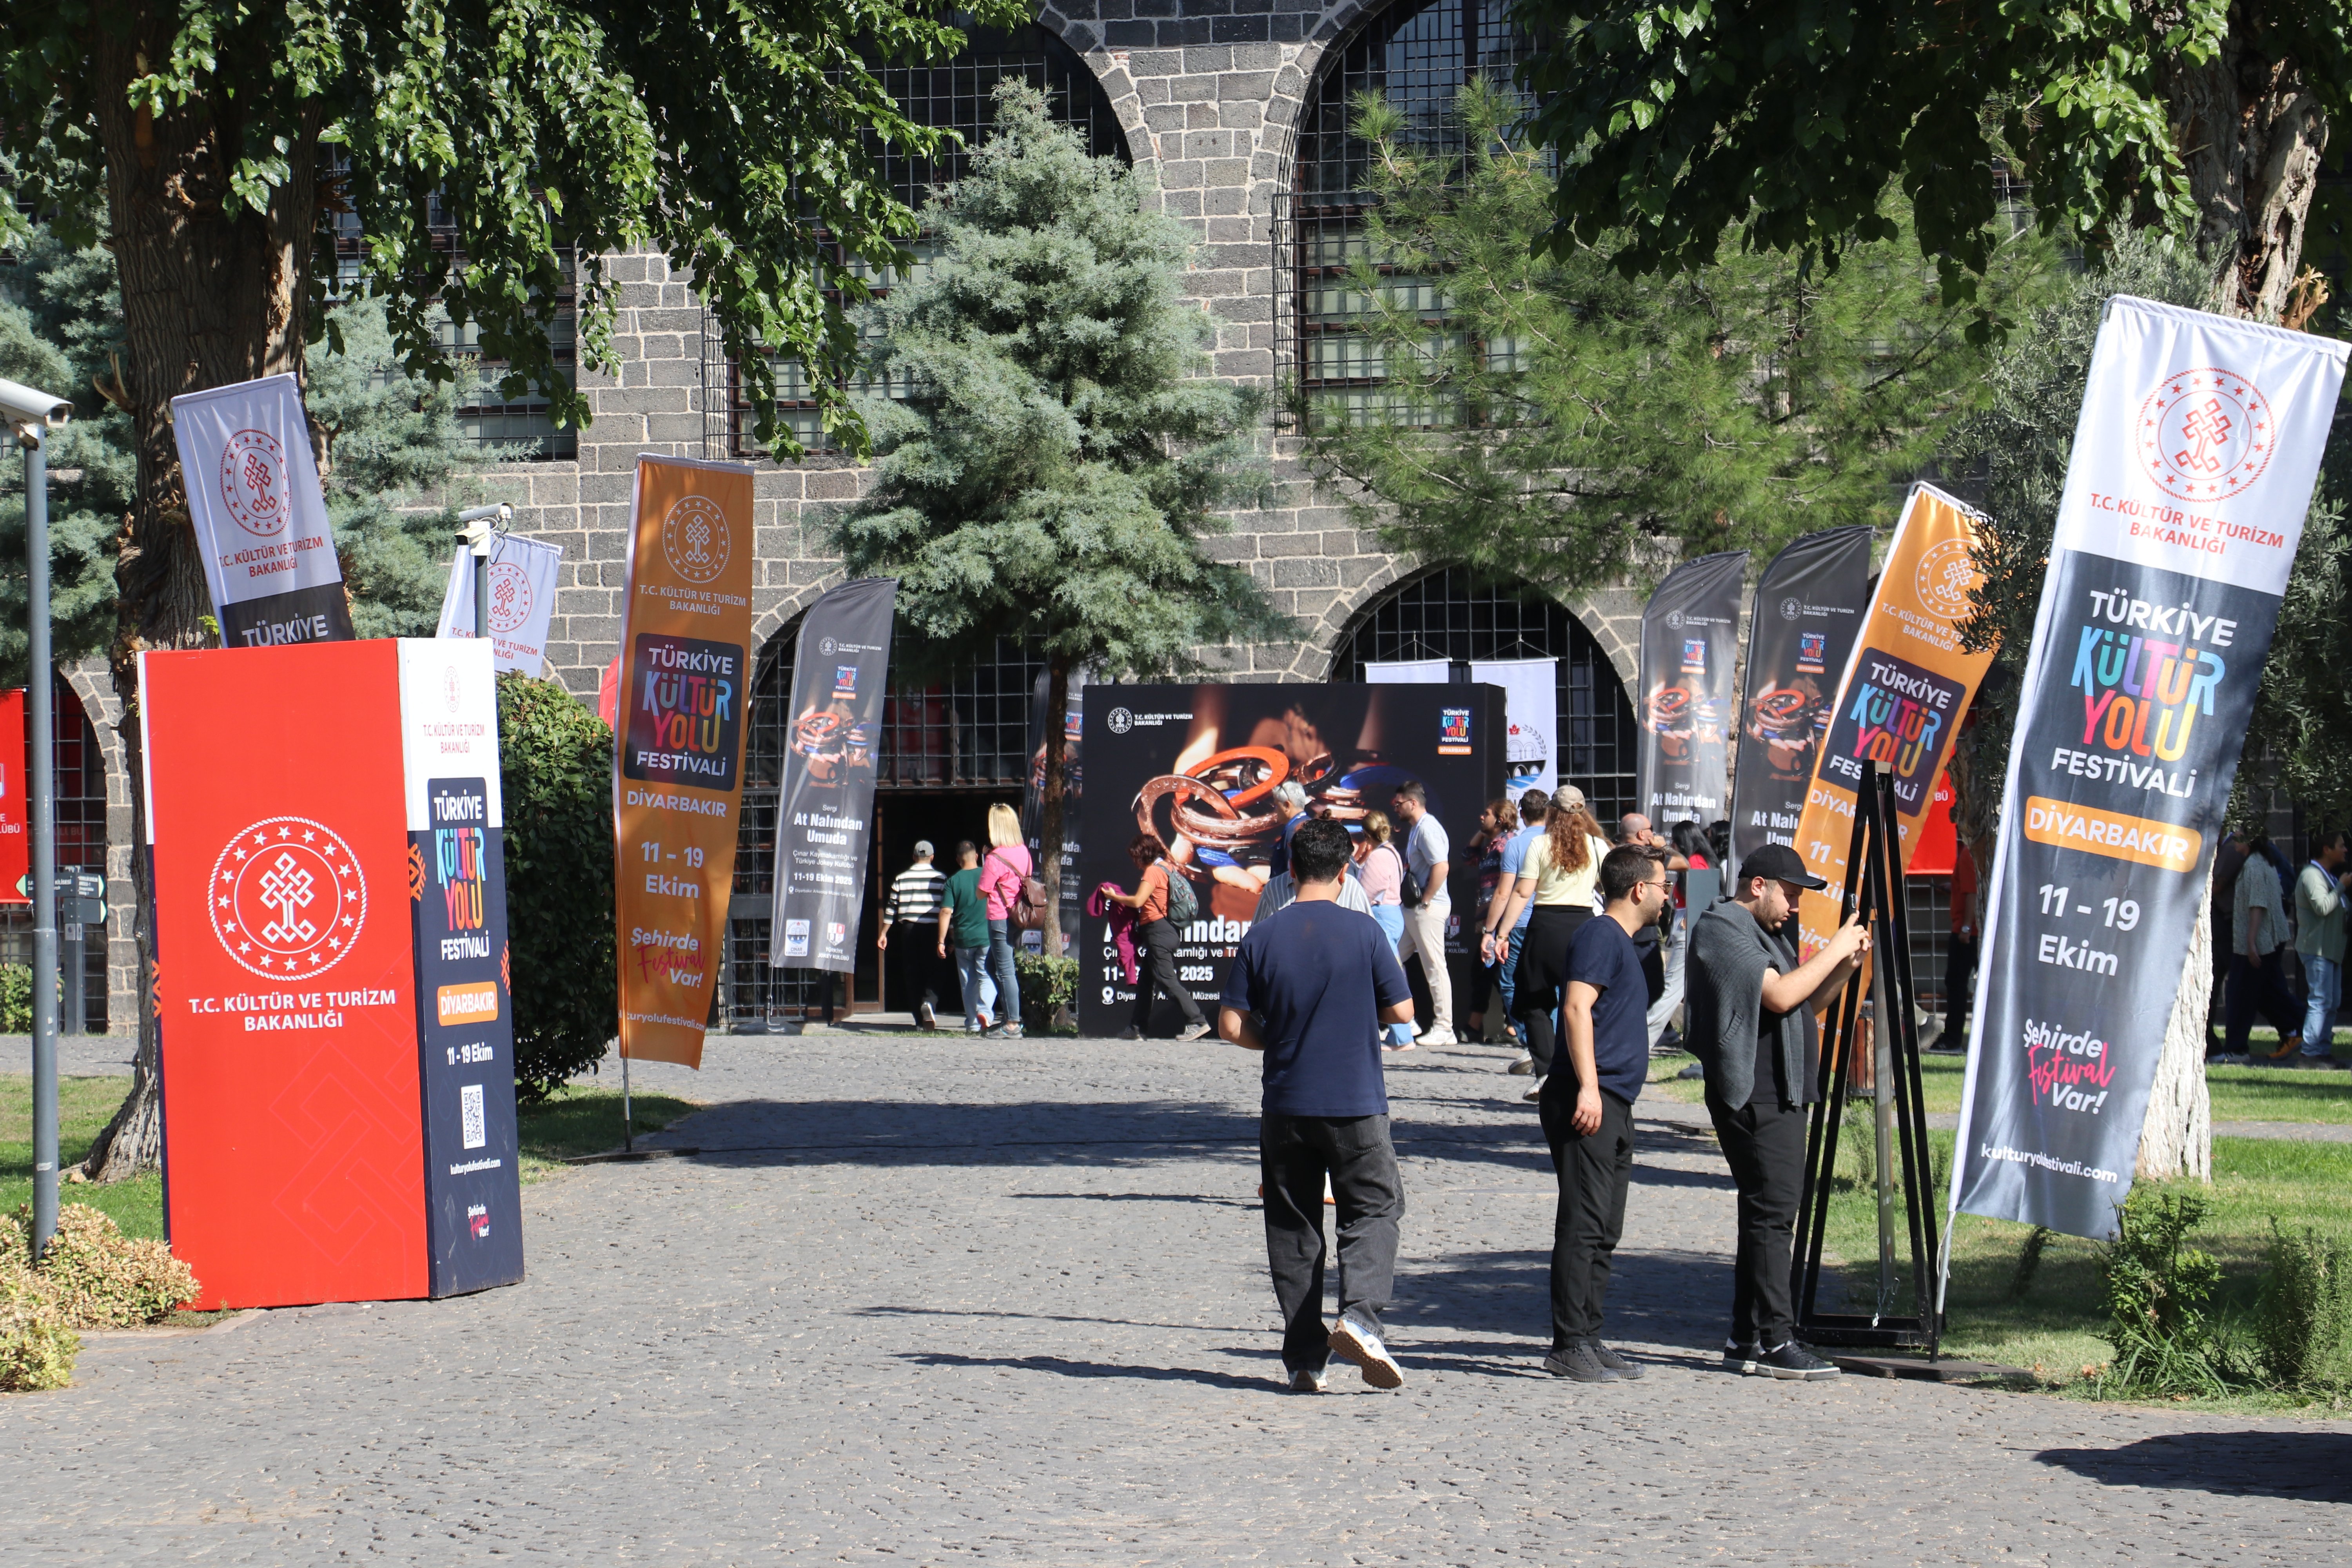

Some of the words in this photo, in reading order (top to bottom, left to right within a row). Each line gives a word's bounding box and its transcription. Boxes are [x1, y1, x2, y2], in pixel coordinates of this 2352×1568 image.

[2091, 493, 2114, 511] T.C.
[2117, 499, 2184, 526] KÜLTÜR
[2190, 515, 2210, 532] VE
[2216, 521, 2284, 549] TURİZM
[234, 545, 275, 564] KÜLTÜR
[277, 544, 287, 555] VE
[288, 536, 323, 553] TURİZM
[2130, 522, 2226, 555] BAKANLIĞI
[249, 557, 297, 577] BAKANLIĞI
[640, 585, 657, 596] T.C.
[661, 586, 697, 600] KÜLTÜR
[700, 592, 711, 602] VE
[713, 593, 746, 606] TURİZM
[670, 601, 720, 615] BAKANLIĞI
[242, 613, 328, 647] TÜRKİYE
[1882, 603, 1896, 616] T.C.
[1898, 610, 1934, 633] KÜLTÜR
[1936, 624, 1949, 637] VE
[2090, 588, 2237, 647] TÜRKİYE
[452, 627, 463, 637] T.C.
[508, 642, 538, 656] TURİZM
[1802, 639, 1824, 650] KÜLTÜR
[1903, 624, 1955, 652] BAKANLIĞI
[648, 644, 733, 675] TÜRKİYE
[1687, 653, 1702, 661] YOLU
[1804, 648, 1821, 657] YOLU
[837, 671, 856, 680] KÜLTÜR
[2071, 626, 2226, 716] KÜLTÜR
[642, 671, 731, 721] KÜLTÜR
[1871, 662, 1952, 710] TÜRKİYE
[423, 725, 433, 737] T.C.
[434, 722, 455, 736] KÜLTÜR
[456, 724, 463, 736] VE
[464, 722, 485, 736] TURİZM
[1443, 716, 1469, 728] KÜLTÜR
[1850, 683, 1942, 752] KÜLTÜR
[2083, 689, 2198, 762] YOLU
[653, 711, 721, 753] YOLU
[1446, 726, 1466, 737] YOLU
[441, 739, 470, 753] BAKANLIĞI
[1853, 726, 1924, 778] YOLU
[637, 751, 726, 777] FESTİVALİ
[2051, 748, 2197, 798] FESTİVALİ
[1829, 755, 1919, 802] FESALİ
[434, 789, 483, 821] TÜRKİYE
[627, 788, 726, 818] DİYARBAKIR
[1651, 793, 1663, 806] At
[1665, 793, 1716, 809] Nalından
[1785, 802, 1802, 811] Sergi
[793, 813, 807, 826] At
[810, 813, 862, 831] Nalından
[1662, 809, 1700, 824] Umuda
[1751, 810, 1768, 827] At
[1770, 812, 1798, 829] Nalı
[807, 830, 847, 845] Umuda
[1029, 838, 1039, 849] At
[2030, 805, 2189, 861] DİYARBAKIR
[436, 827, 486, 889] KÜLTÜR
[641, 842, 660, 862] 11
[684, 847, 703, 868] 19
[809, 851, 849, 862] Kaymakamlığı
[817, 859, 833, 867] Jokey
[1810, 841, 1831, 864] 11
[646, 875, 699, 898] Ekim
[794, 872, 814, 881] 11-19
[816, 874, 833, 883] Ekim
[835, 875, 853, 885] 2025
[445, 875, 483, 931] YOLU
[2039, 884, 2069, 917] 11
[2103, 897, 2140, 931] 19
[441, 929, 489, 960] FESTİVALİ
[630, 927, 698, 951] Şehirde
[637, 941, 705, 984] Festival
[1211, 949, 1223, 957] ve
[2038, 934, 2118, 976] Ekim
[670, 968, 702, 988] Var!
[1180, 966, 1213, 981] 2025
[189, 998, 220, 1013] T.C.
[224, 992, 293, 1011] KÜLTÜR
[298, 993, 321, 1009] VE
[326, 987, 396, 1007] TURİZM
[441, 990, 495, 1016] DİYARBAKIR
[1193, 992, 1220, 1000] Müzesi
[244, 1010, 343, 1032] BAKANLIĞI
[2024, 1018, 2103, 1058] Şehirde
[447, 1047, 455, 1065] 11
[461, 1045, 470, 1063] 19
[472, 1042, 493, 1062] Ekim
[2028, 1042, 2116, 1105] Festival
[2053, 1082, 2108, 1114] Var!
[451, 1158, 501, 1175] kulturyolufestivali.com
[468, 1203, 486, 1219] Şehirde
[479, 1225, 489, 1238] Var!
